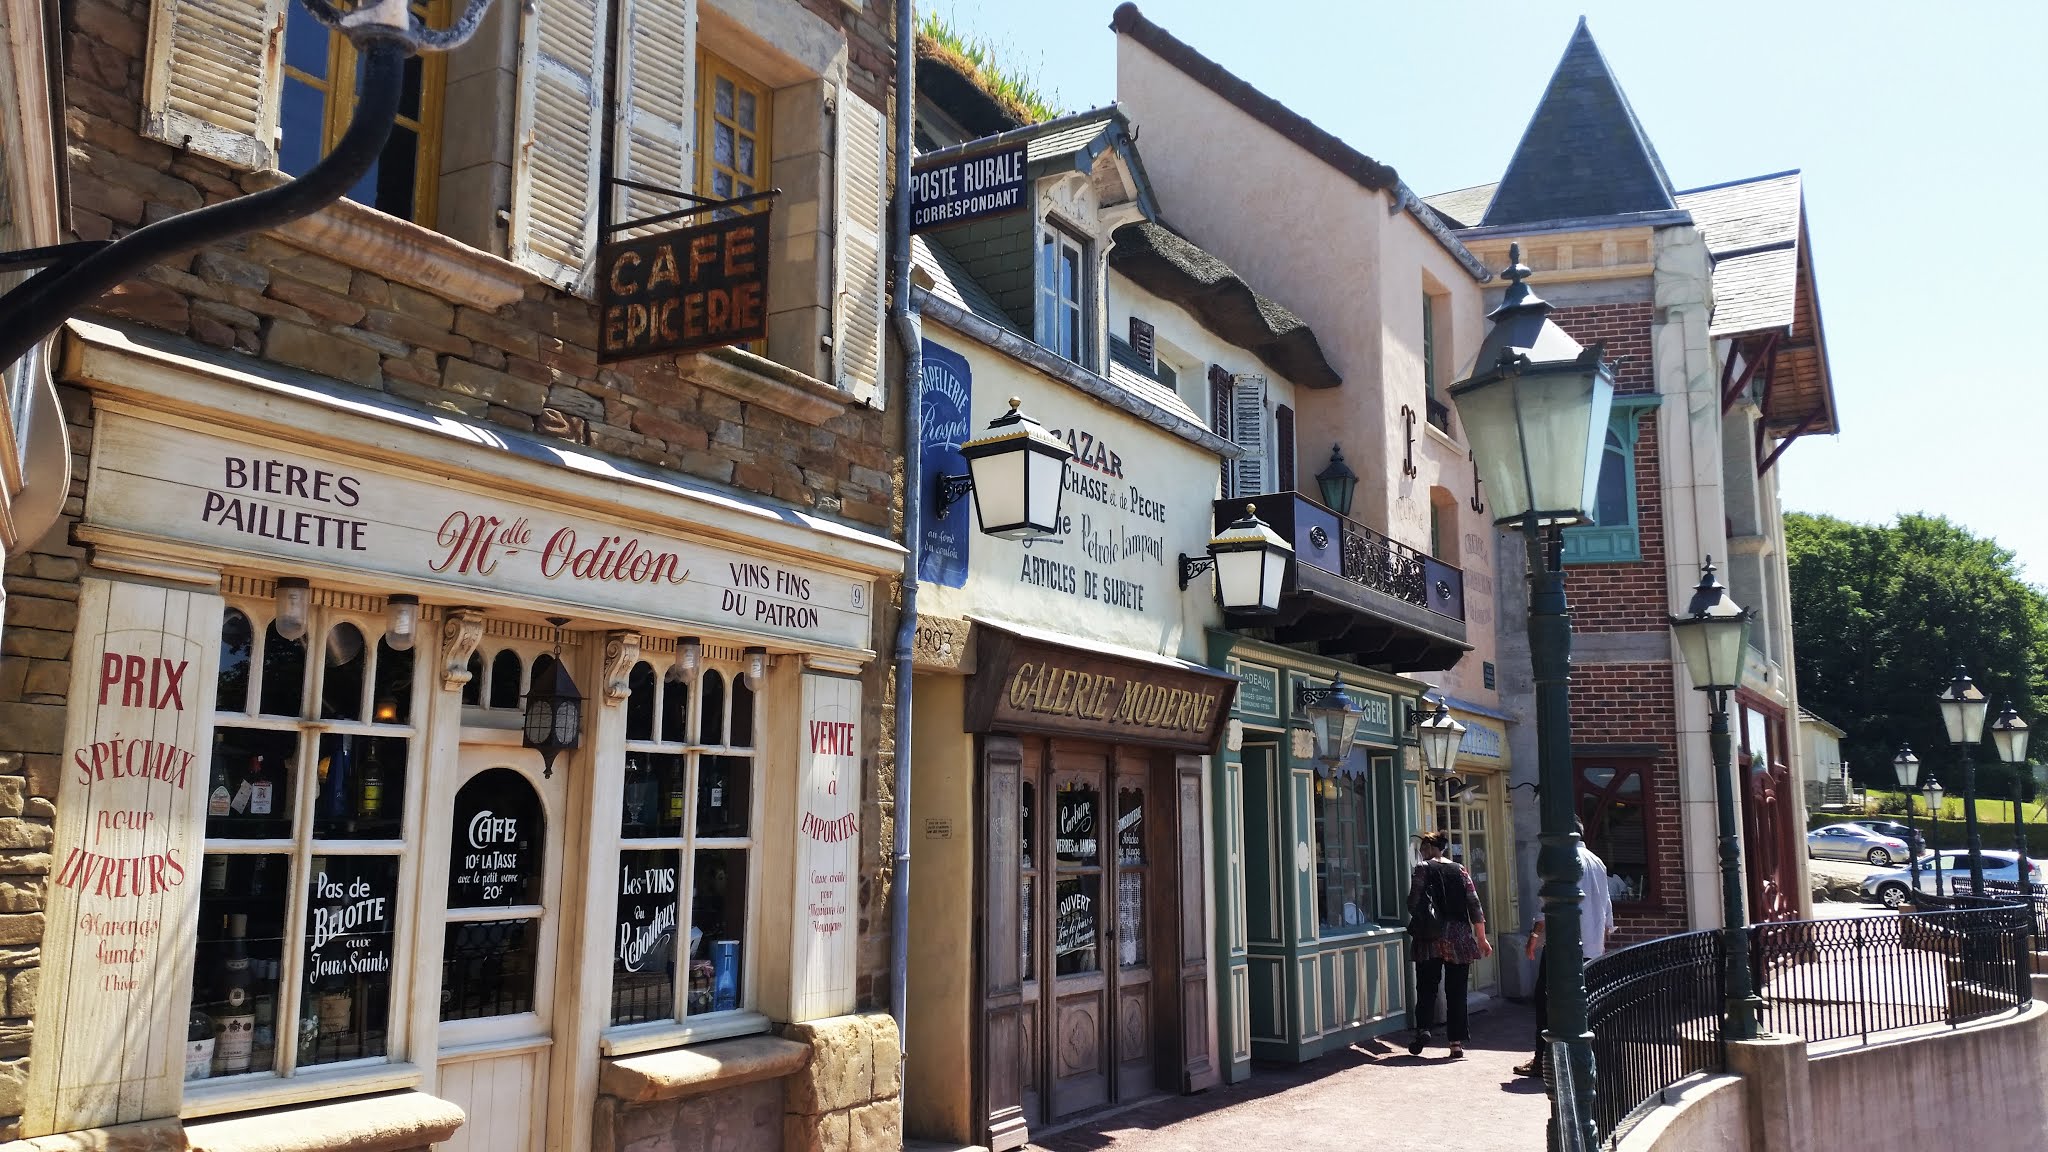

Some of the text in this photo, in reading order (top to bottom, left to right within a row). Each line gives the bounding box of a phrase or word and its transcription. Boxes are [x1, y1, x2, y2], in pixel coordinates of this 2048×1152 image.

[911, 151, 1023, 204] POSTE RURALE
[915, 188, 1019, 225] CORRESPONDANT
[610, 227, 755, 296] CAFE
[606, 282, 761, 350] EPICERIE
[226, 456, 361, 507] BIÈRES
[1063, 463, 1108, 504] CHASSE
[1109, 489, 1118, 508] et
[1120, 492, 1128, 510] de
[202, 491, 368, 551] PAILLETTE
[541, 527, 690, 584] Odilon
[1121, 524, 1164, 566] lampant
[729, 562, 810, 601] VINS FINS
[1020, 554, 1077, 595] ARTICLES
[1084, 570, 1098, 600] DE
[721, 589, 818, 629] DU PATRON
[853, 592, 862, 605] 9
[915, 627, 953, 655] 1903
[99, 652, 189, 711] PRIX
[1009, 661, 1215, 733] GALERIE MODERNE
[809, 719, 855, 757] VENTE
[74, 732, 196, 790] SPÉCIAUX
[95, 810, 156, 846] pour
[801, 811, 859, 843] EMPORTER
[1056, 838, 1075, 853] VERRES
[54, 847, 186, 900] LIVREURS
[473, 870, 480, 884] le
[492, 850, 517, 870] TASSE
[623, 864, 675, 895] Les VINS
[317, 871, 371, 899] Pas de
[1060, 893, 1092, 916] OUVERT
[310, 897, 386, 952] BELOTTE
[345, 938, 371, 949] aux
[619, 901, 676, 973] Rebouteux
[309, 950, 389, 985] Jours Saints
